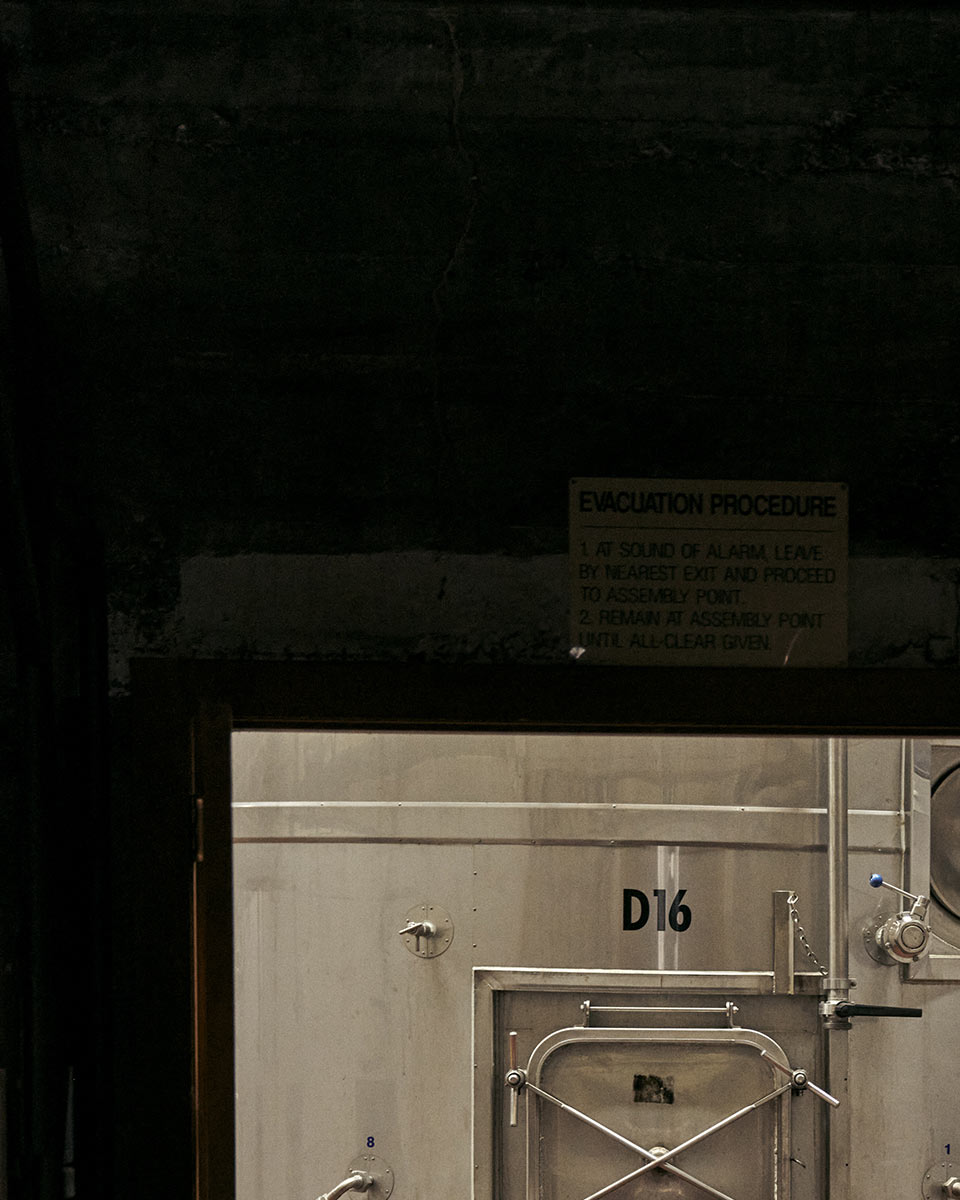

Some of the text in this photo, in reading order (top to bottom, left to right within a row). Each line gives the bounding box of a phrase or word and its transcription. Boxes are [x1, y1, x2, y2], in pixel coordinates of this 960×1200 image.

[580, 491, 837, 517] EVACUATION PROCEDURE
[596, 541, 614, 557] AT
[620, 542, 675, 558] SOUND
[681, 543, 700, 559] OF
[706, 543, 768, 562] ALARM,
[775, 544, 823, 561] LEAVE
[579, 563, 836, 584] BY NEAREST EXIT AND PROCEED
[581, 586, 602, 602] TO
[606, 586, 689, 604] ASSEMBLY
[600, 609, 660, 626] REMAIN
[666, 610, 684, 627] AT
[690, 611, 772, 628] ASSEMBLY
[778, 612, 825, 629] POINT
[579, 631, 624, 649] UNTIL
[629, 632, 716, 650] ALL-CLEAR
[623, 888, 692, 932] D16
[366, 1136, 375, 1148] 8
[944, 1143, 950, 1155] 1
